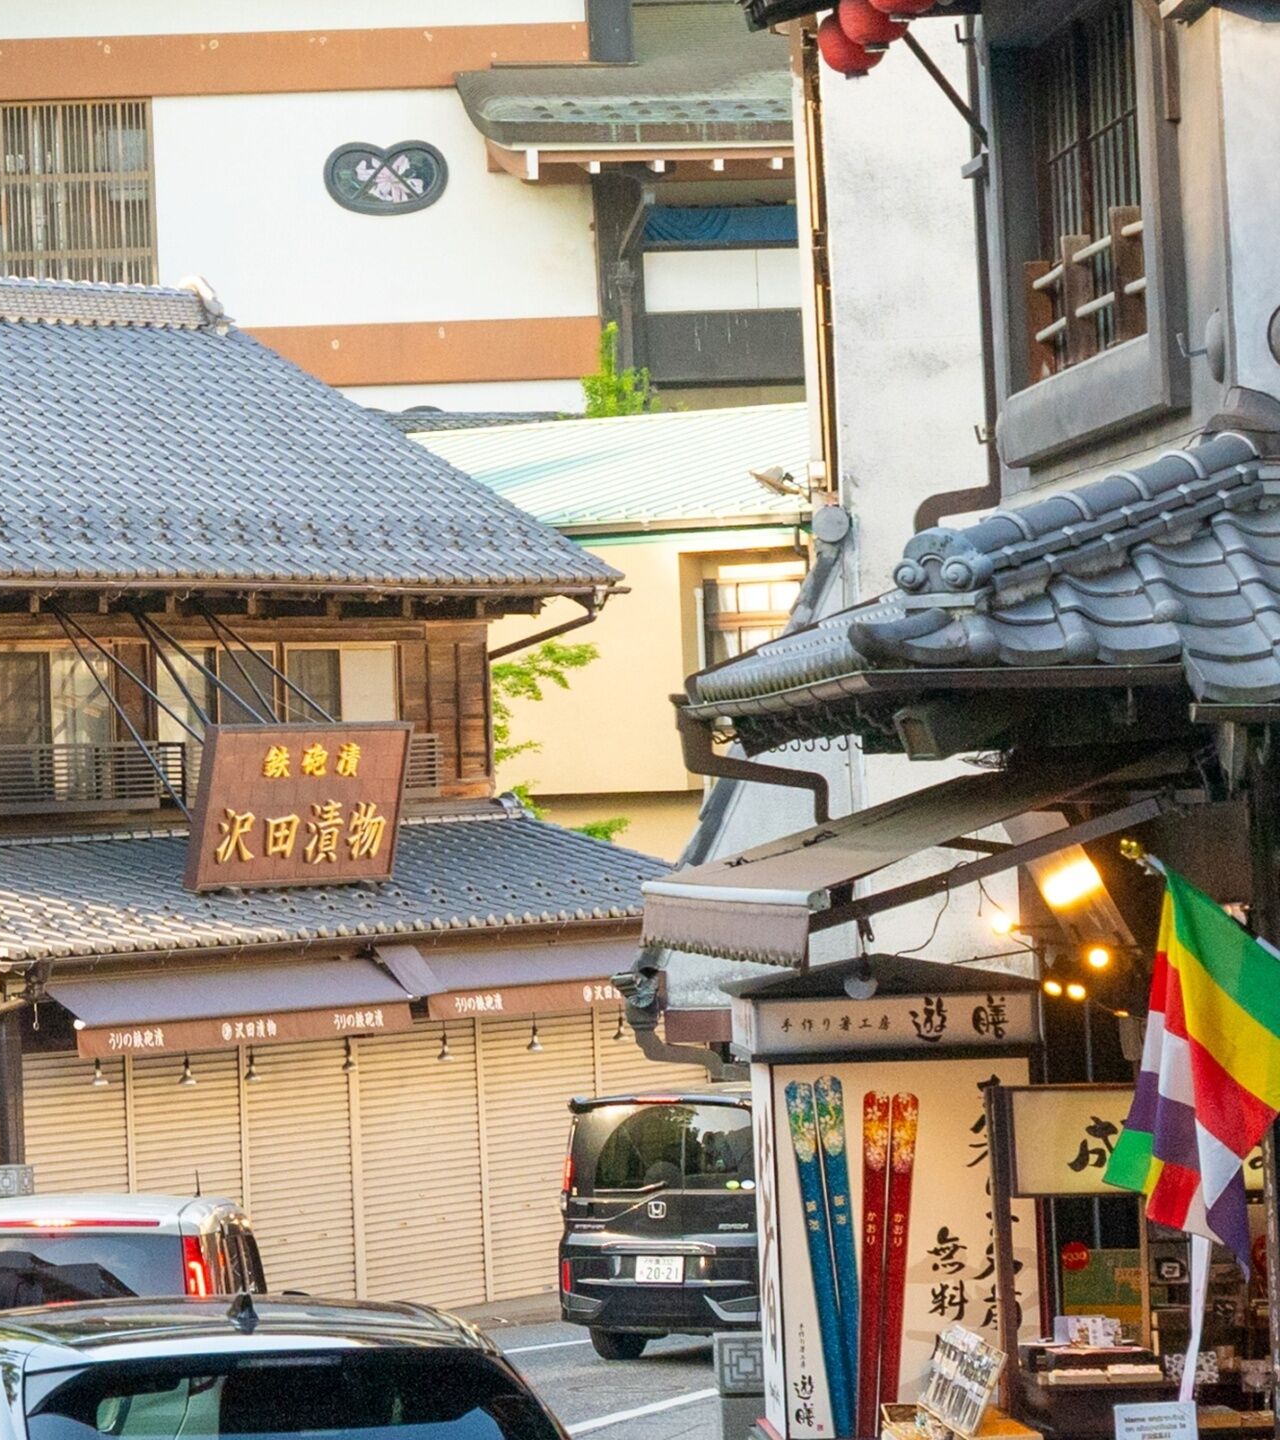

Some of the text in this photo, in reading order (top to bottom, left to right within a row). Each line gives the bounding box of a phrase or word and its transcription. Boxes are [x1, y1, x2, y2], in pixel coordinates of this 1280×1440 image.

[263, 742, 362, 779] 鉄砲漬
[215, 799, 387, 865] 沢田漬物
